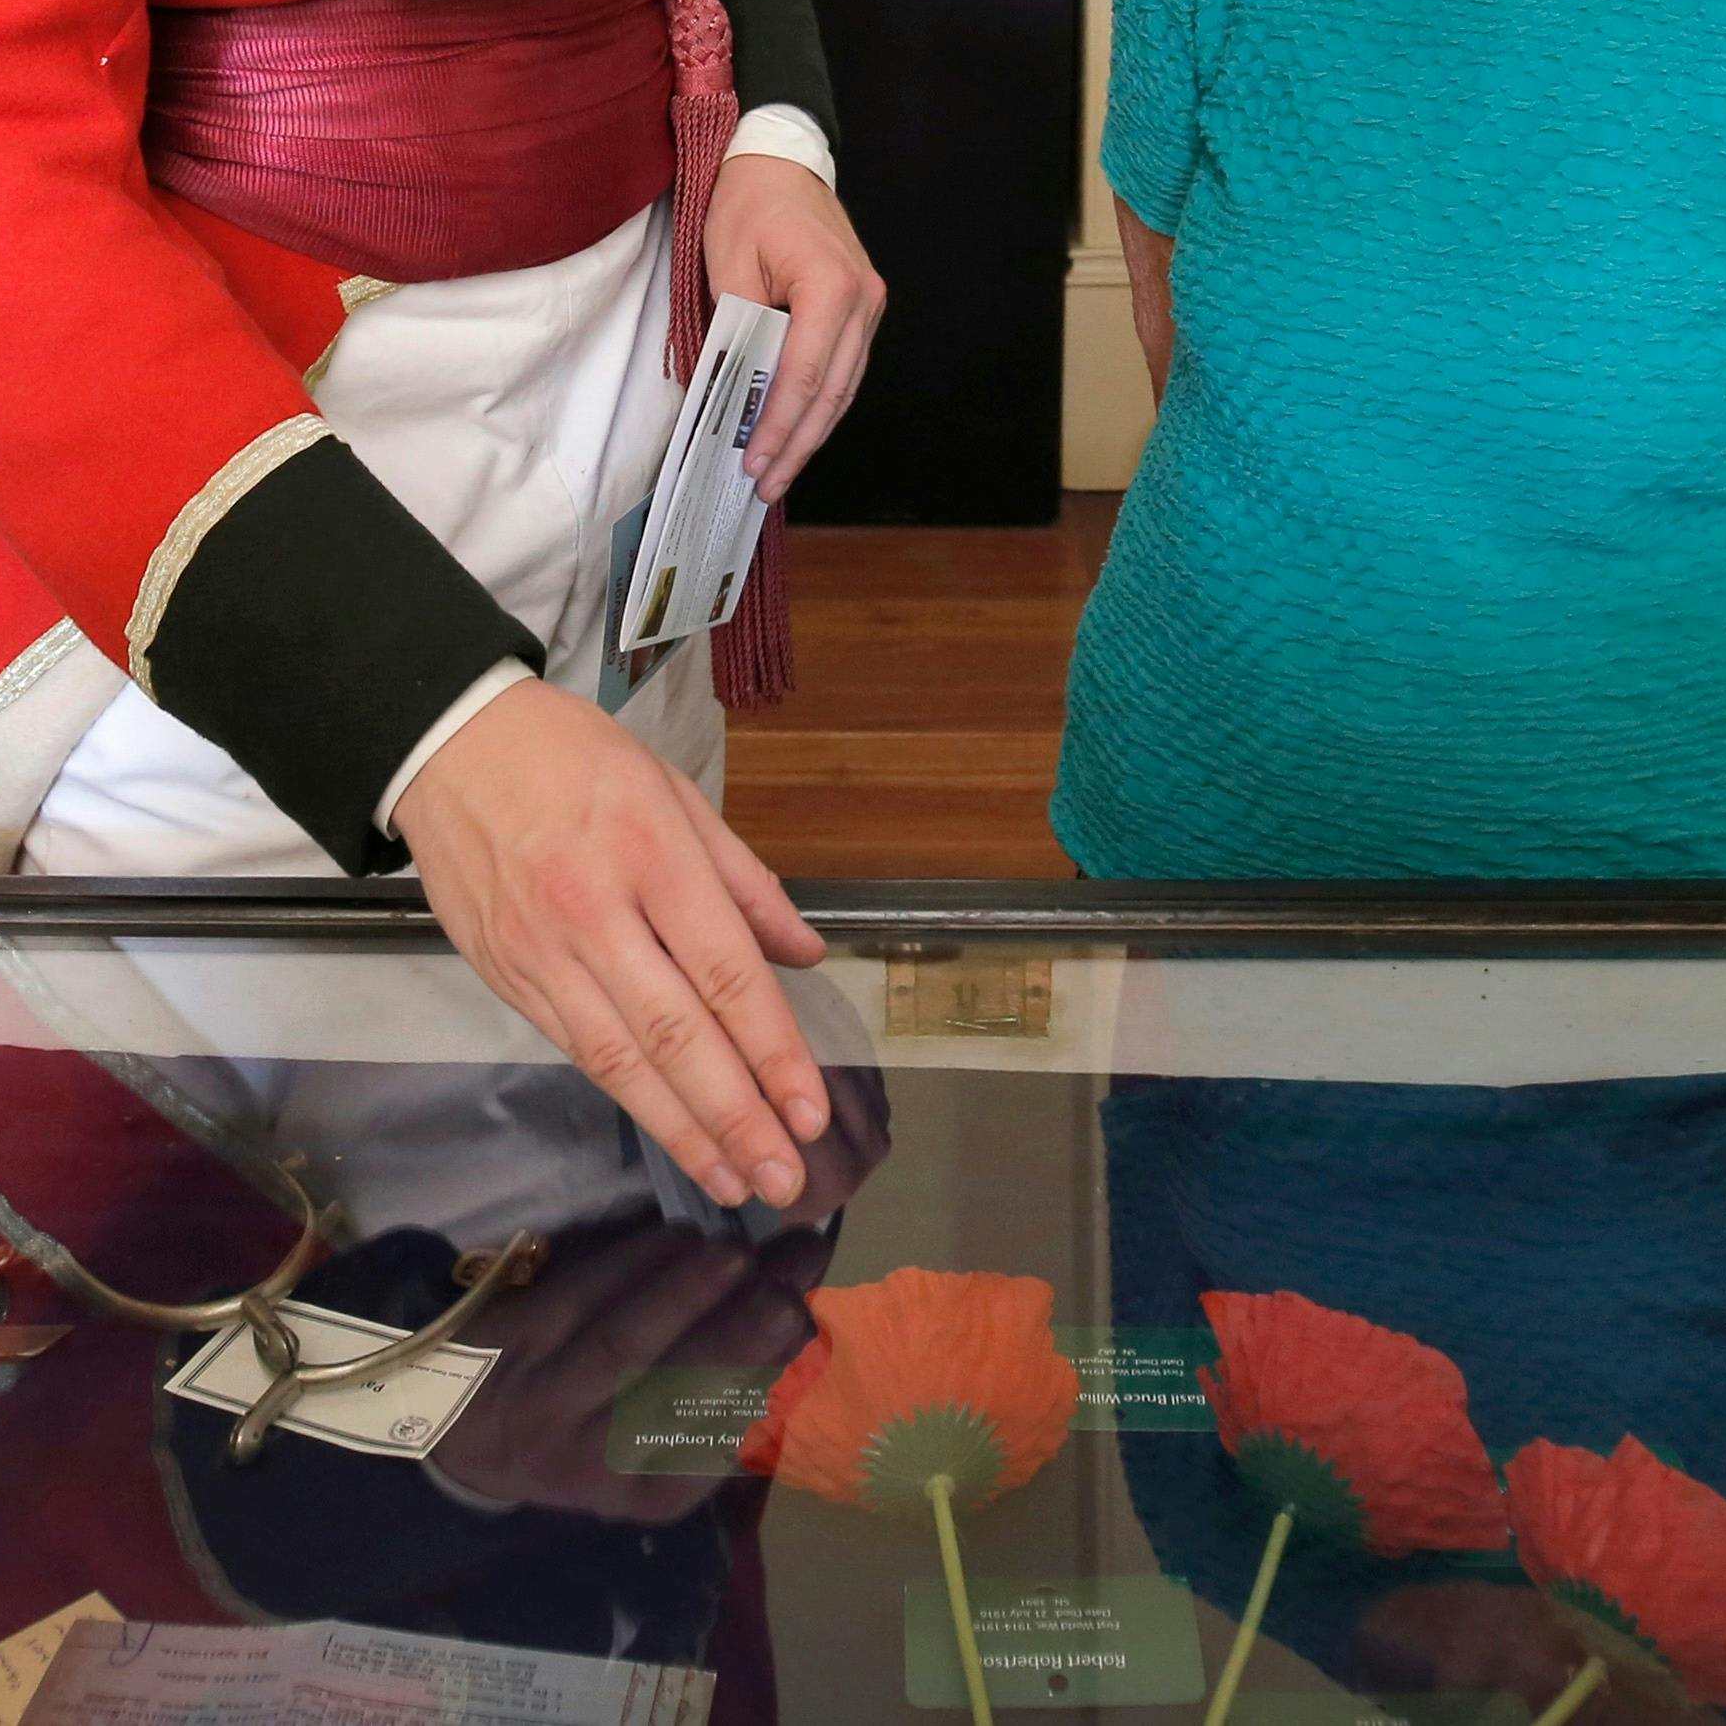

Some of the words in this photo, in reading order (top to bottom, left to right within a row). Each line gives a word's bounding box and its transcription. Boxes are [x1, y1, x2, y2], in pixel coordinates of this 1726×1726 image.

[1131, 1368, 1162, 1377] World
[1123, 1393, 1167, 1405] Bruce
[1172, 1393, 1206, 1405] Basil
[636, 1432, 714, 1447] Longhurst
[1010, 1609, 1031, 1619] July
[1086, 1609, 1112, 1618] Date
[1060, 1621, 1095, 1632] World
[1097, 1621, 1120, 1631] First
[978, 1653, 1062, 1671] Robertso
[1068, 1653, 1126, 1670] Robert
